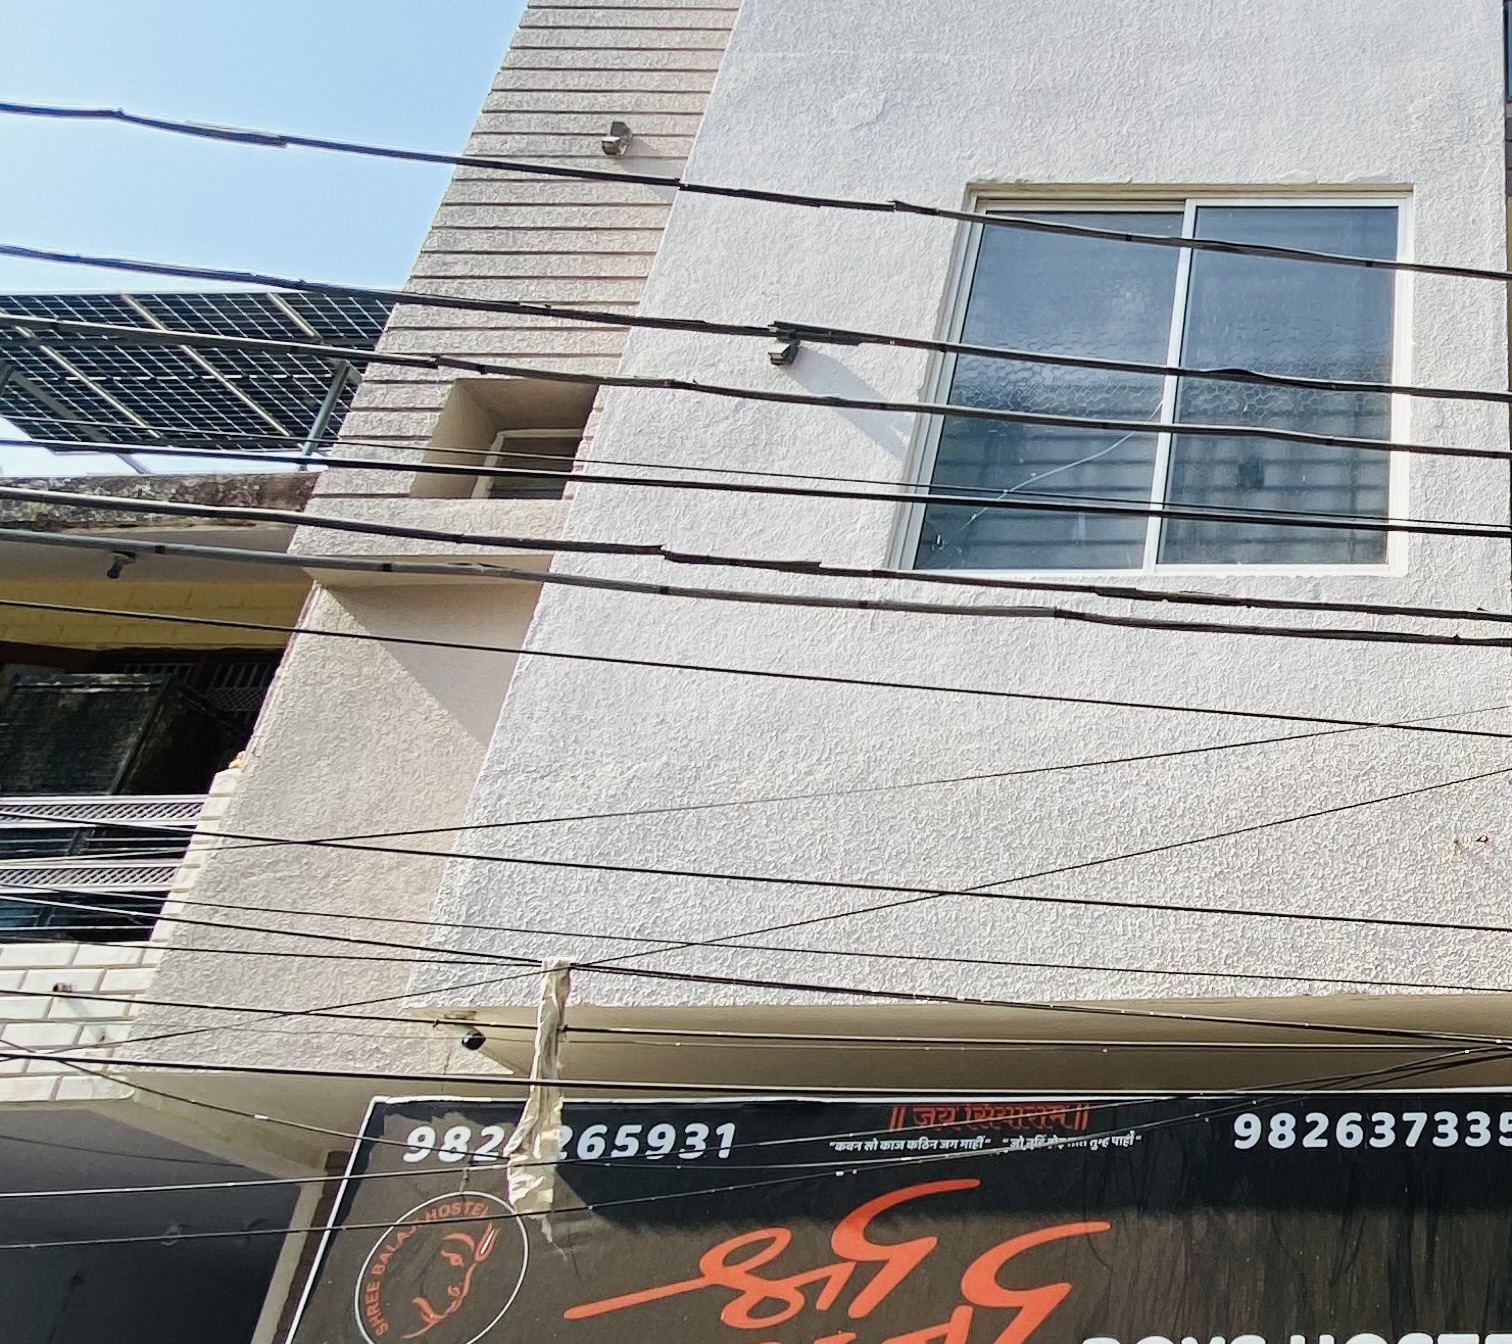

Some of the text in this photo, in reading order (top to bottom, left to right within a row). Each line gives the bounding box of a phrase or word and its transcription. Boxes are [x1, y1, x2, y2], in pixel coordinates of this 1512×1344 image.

[402, 1122, 736, 1162] 982265931
[370, 1218, 423, 1276] BALAJ
[563, 1177, 981, 1329] श्री
[364, 1280, 389, 1337] SHREE
